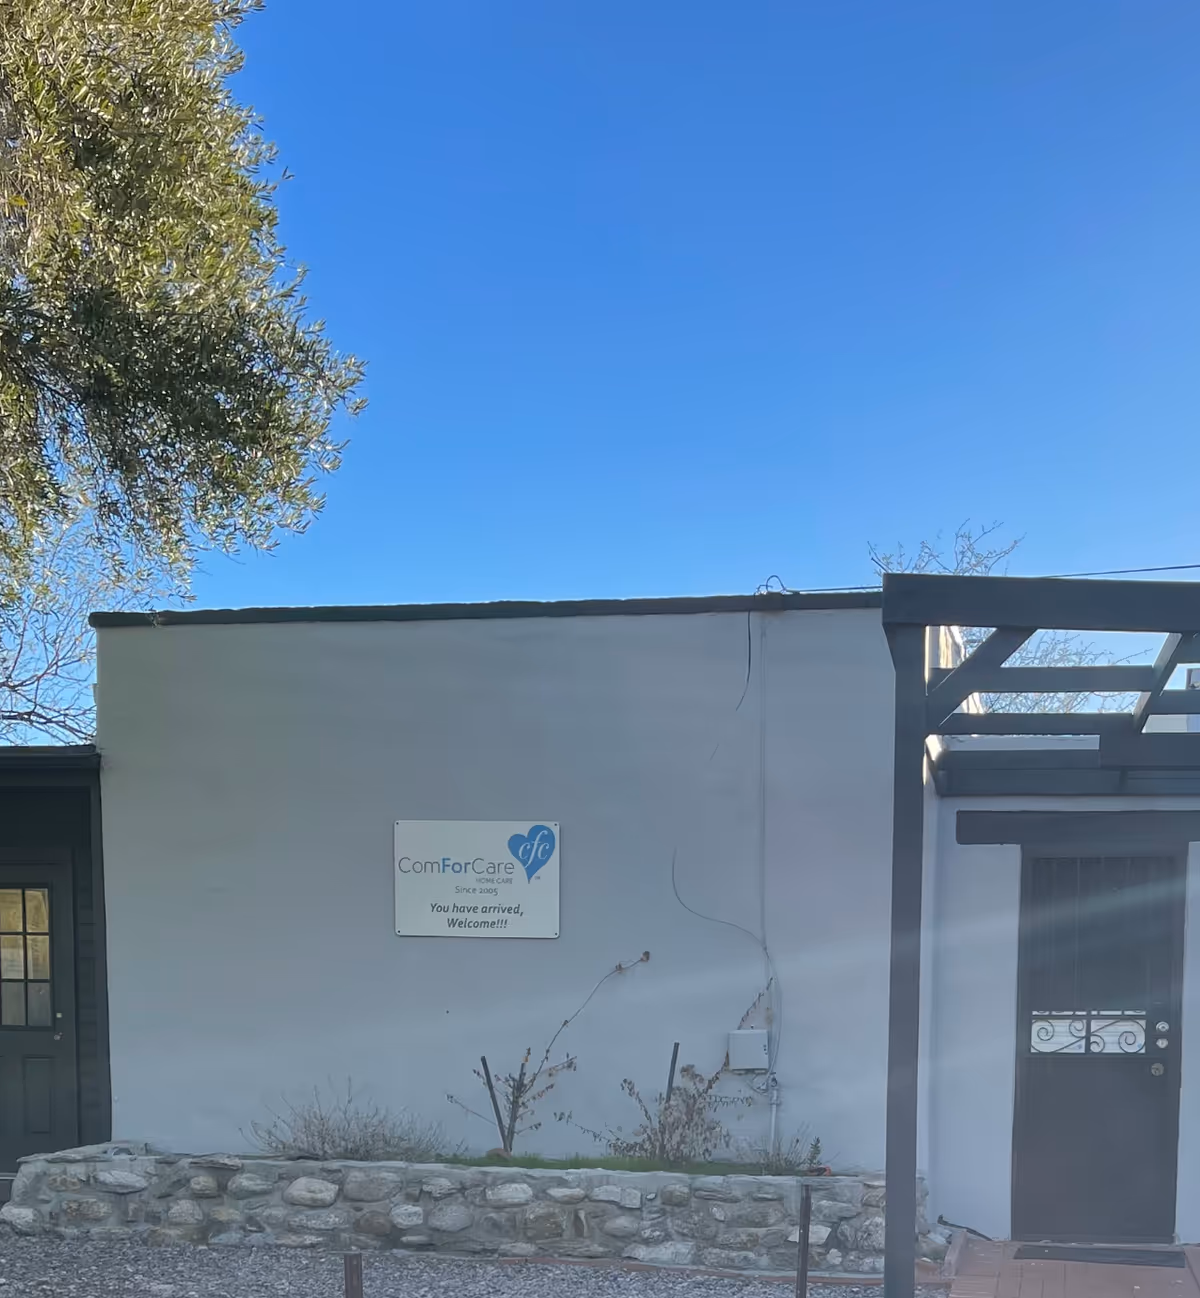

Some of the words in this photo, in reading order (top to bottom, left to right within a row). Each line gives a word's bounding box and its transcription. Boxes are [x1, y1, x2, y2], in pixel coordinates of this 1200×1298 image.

[518, 829, 550, 868] cfc
[398, 856, 515, 874] ComForCare
[454, 885, 477, 894] Since
[479, 887, 499, 896] 2005
[430, 902, 449, 913] You
[452, 902, 478, 914] have
[481, 903, 524, 917] arrived,
[446, 917, 508, 929] Welcome!!!
